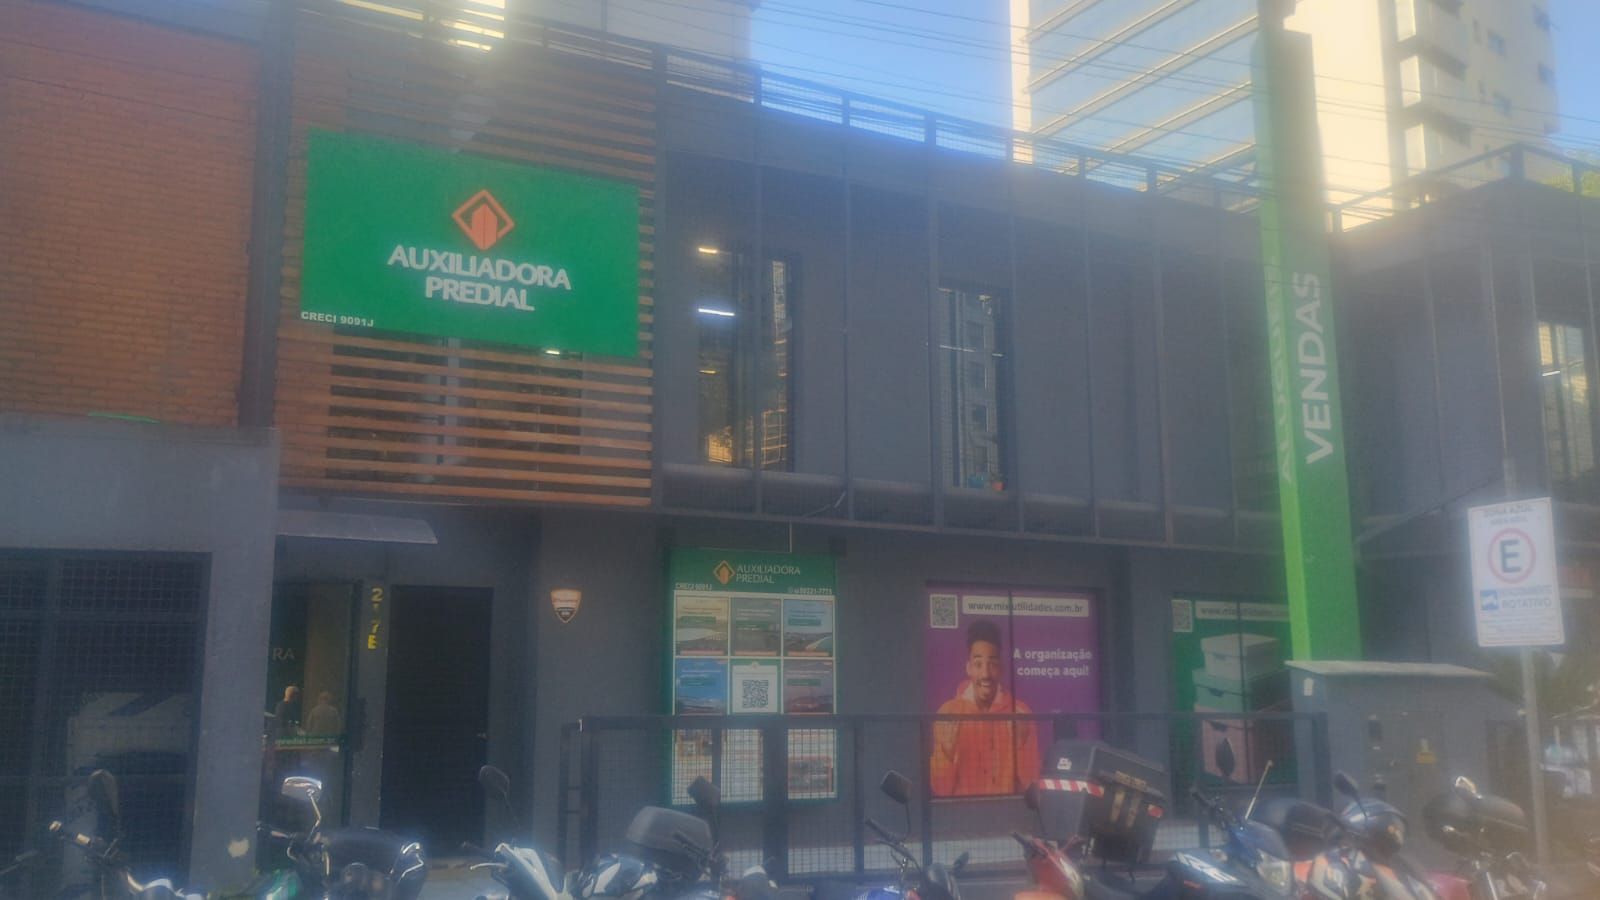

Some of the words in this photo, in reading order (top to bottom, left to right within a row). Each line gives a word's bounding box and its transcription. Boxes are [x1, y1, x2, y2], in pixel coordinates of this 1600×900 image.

[387, 245, 571, 290] AUXILIADORA
[425, 277, 535, 311] PREDIAL
[301, 311, 337, 323] CRECI
[340, 315, 374, 327] 9091J
[1291, 271, 1334, 465] VENDAS
[1499, 539, 1522, 573] E
[736, 564, 801, 575] AUXILIADORA
[736, 573, 775, 584] PREDIAL
[1013, 648, 1021, 659] A
[1024, 648, 1092, 662] organização
[1016, 667, 1060, 678] começa
[1063, 664, 1089, 678] aqui!
